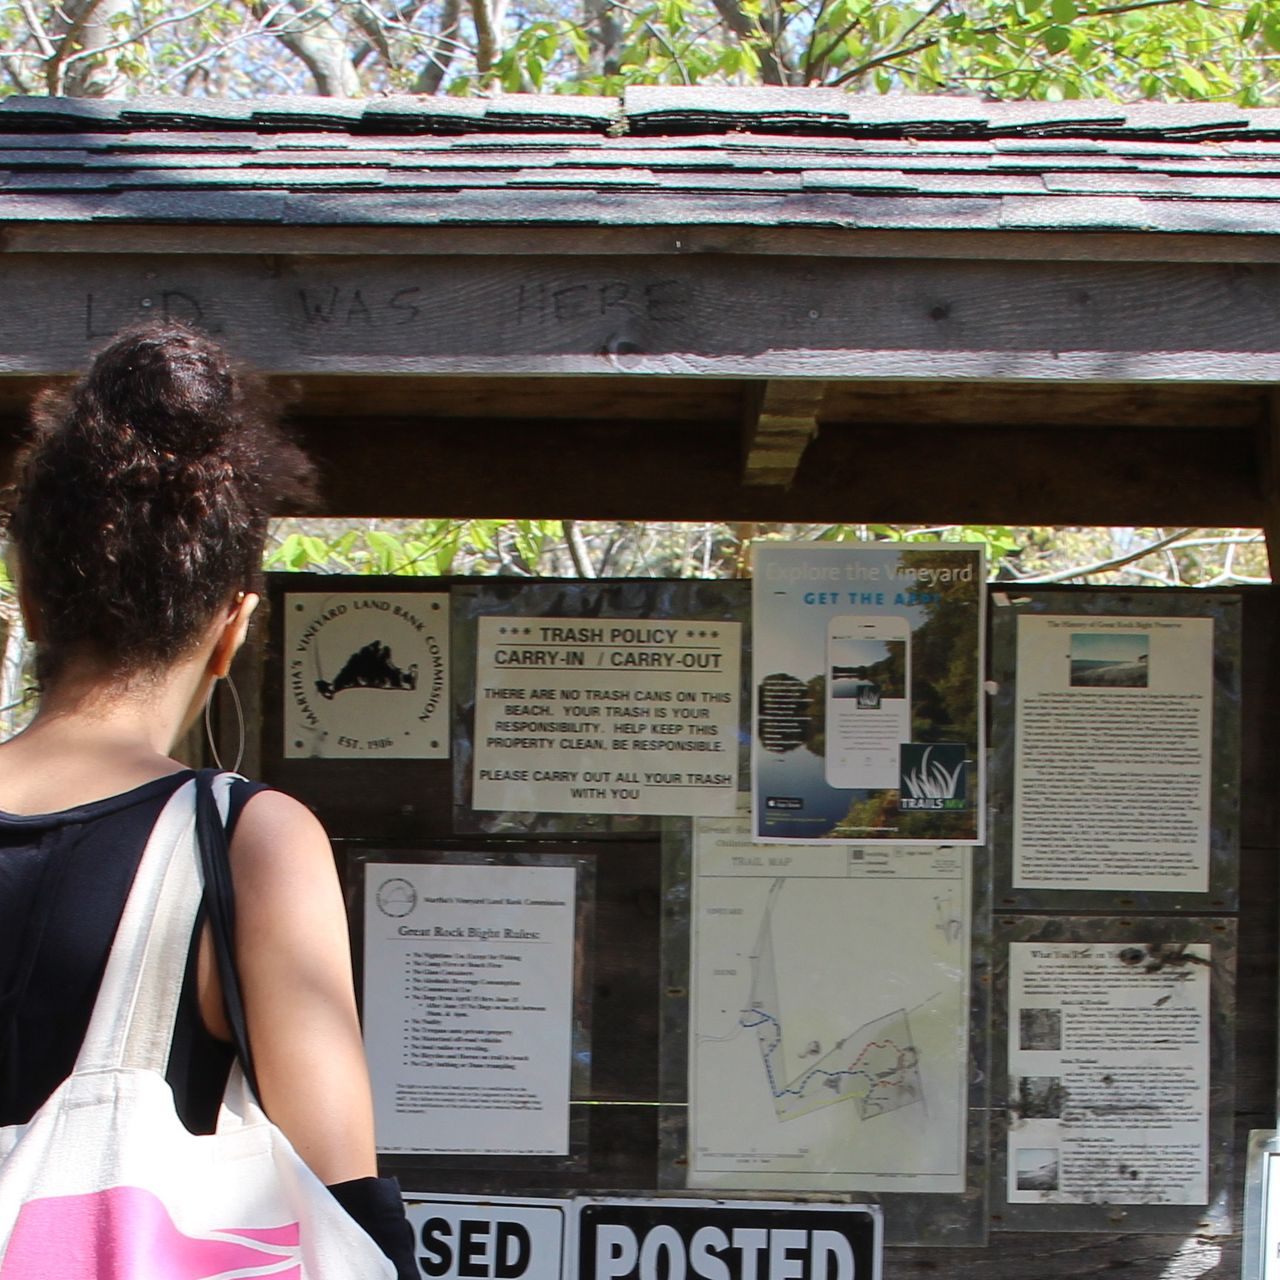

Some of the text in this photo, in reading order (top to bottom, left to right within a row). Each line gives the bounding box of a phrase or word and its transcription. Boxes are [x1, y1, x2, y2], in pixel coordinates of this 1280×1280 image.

[298, 284, 422, 328] WAS
[516, 279, 688, 326] HERE
[843, 561, 879, 581] the
[883, 561, 973, 588] Vineyard
[803, 592, 839, 605] GET
[848, 592, 884, 605] THE
[540, 627, 677, 643] TRASH POLICY
[296, 604, 348, 653] VINEYARD
[352, 599, 391, 612] LAND
[392, 604, 425, 632] BANK
[416, 635, 444, 723] COMMISSION
[494, 651, 584, 665] CARRY-IN
[610, 653, 721, 668] CARRY-OUT
[484, 688, 731, 703] THERE ARE NO TRASH CANS ON THIS
[505, 705, 709, 719] BEACH. YOUR TRASH IS YOUR
[613, 723, 646, 733] HELP
[651, 724, 683, 734] KEEP
[688, 725, 718, 735] THIS
[487, 738, 555, 749] PROPERTY
[611, 740, 628, 750] BE
[480, 770, 732, 784] PLEASE CARRY OUT ALL YOUR TRASH
[570, 789, 640, 799] WITH YOU
[901, 798, 944, 809] TRAILS
[398, 925, 431, 938] Great
[433, 926, 465, 939] Rock
[412, 1216, 531, 1279] SED
